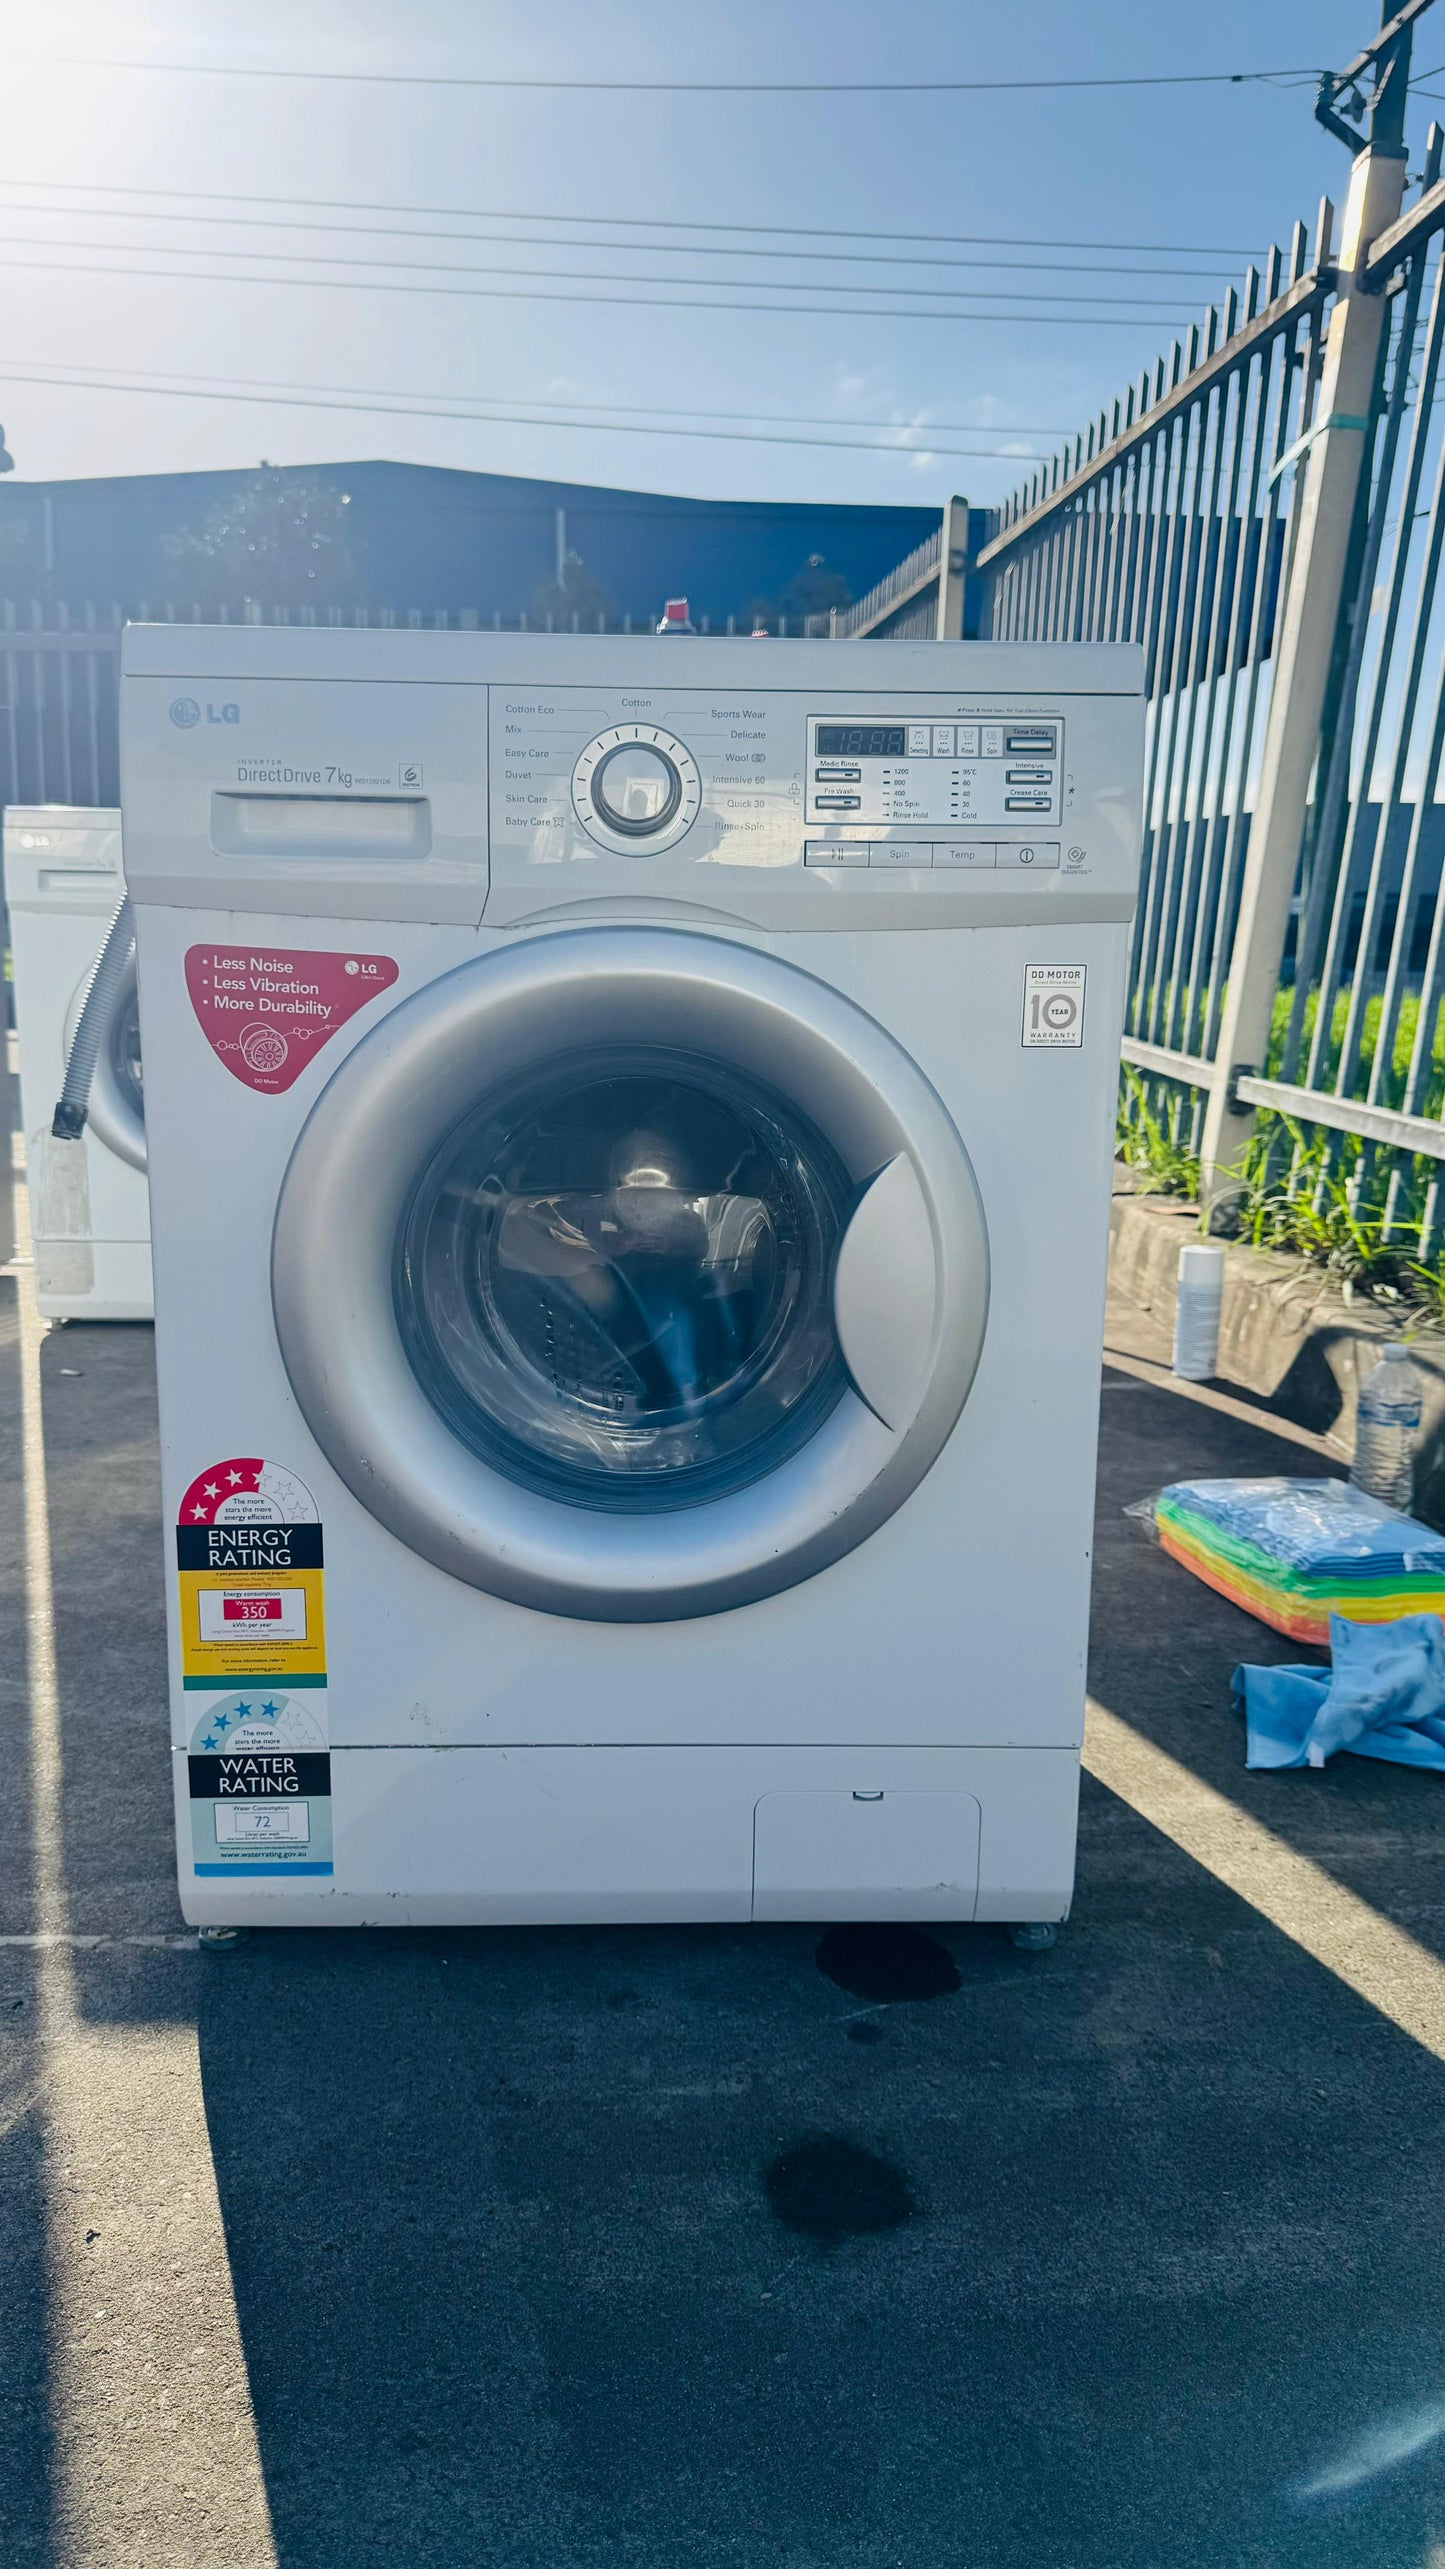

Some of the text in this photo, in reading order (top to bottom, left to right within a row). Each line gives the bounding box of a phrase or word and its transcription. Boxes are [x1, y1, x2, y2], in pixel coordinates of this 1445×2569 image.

[622, 698, 652, 708] Cotton
[206, 703, 240, 724] LG
[505, 705, 555, 715] Cotton Eco
[711, 709, 766, 720] Sports Wear
[505, 725, 522, 734] Mix
[730, 730, 766, 740] Delicate
[1012, 728, 1049, 737] Time Delay
[505, 749, 550, 760] Easy Care
[909, 747, 929, 755] Detecting
[725, 753, 749, 763] Wool
[820, 760, 859, 768] Medic Rinse
[325, 766, 353, 788] 7kg
[505, 770, 532, 780] Duvet
[711, 775, 766, 785] Intensive 60
[824, 787, 836, 795] Pre
[1031, 789, 1048, 797] Care
[505, 794, 548, 804] Skin Care
[726, 799, 765, 809] Quick 30
[893, 800, 920, 809] No Spin
[893, 811, 928, 819] Rinse Hold
[961, 811, 977, 820] Cold
[505, 817, 551, 828] Baby Care
[714, 821, 765, 832] Rinse+Spin
[889, 849, 910, 861] Spin
[950, 850, 975, 861] Temp
[213, 955, 294, 973] Less Noise
[361, 963, 377, 974] LG
[1031, 970, 1081, 979] DD MOTOR
[213, 975, 319, 995] Less Vibration
[214, 995, 331, 1019] More Durability
[1030, 993, 1077, 1030] 10
[208, 1529, 293, 1547] ENERGY
[209, 1549, 291, 1566] RATING
[242, 1606, 267, 1619] 350
[219, 1757, 296, 1774] WATER
[219, 1777, 299, 1793] RATING
[254, 1815, 271, 1827] 72
